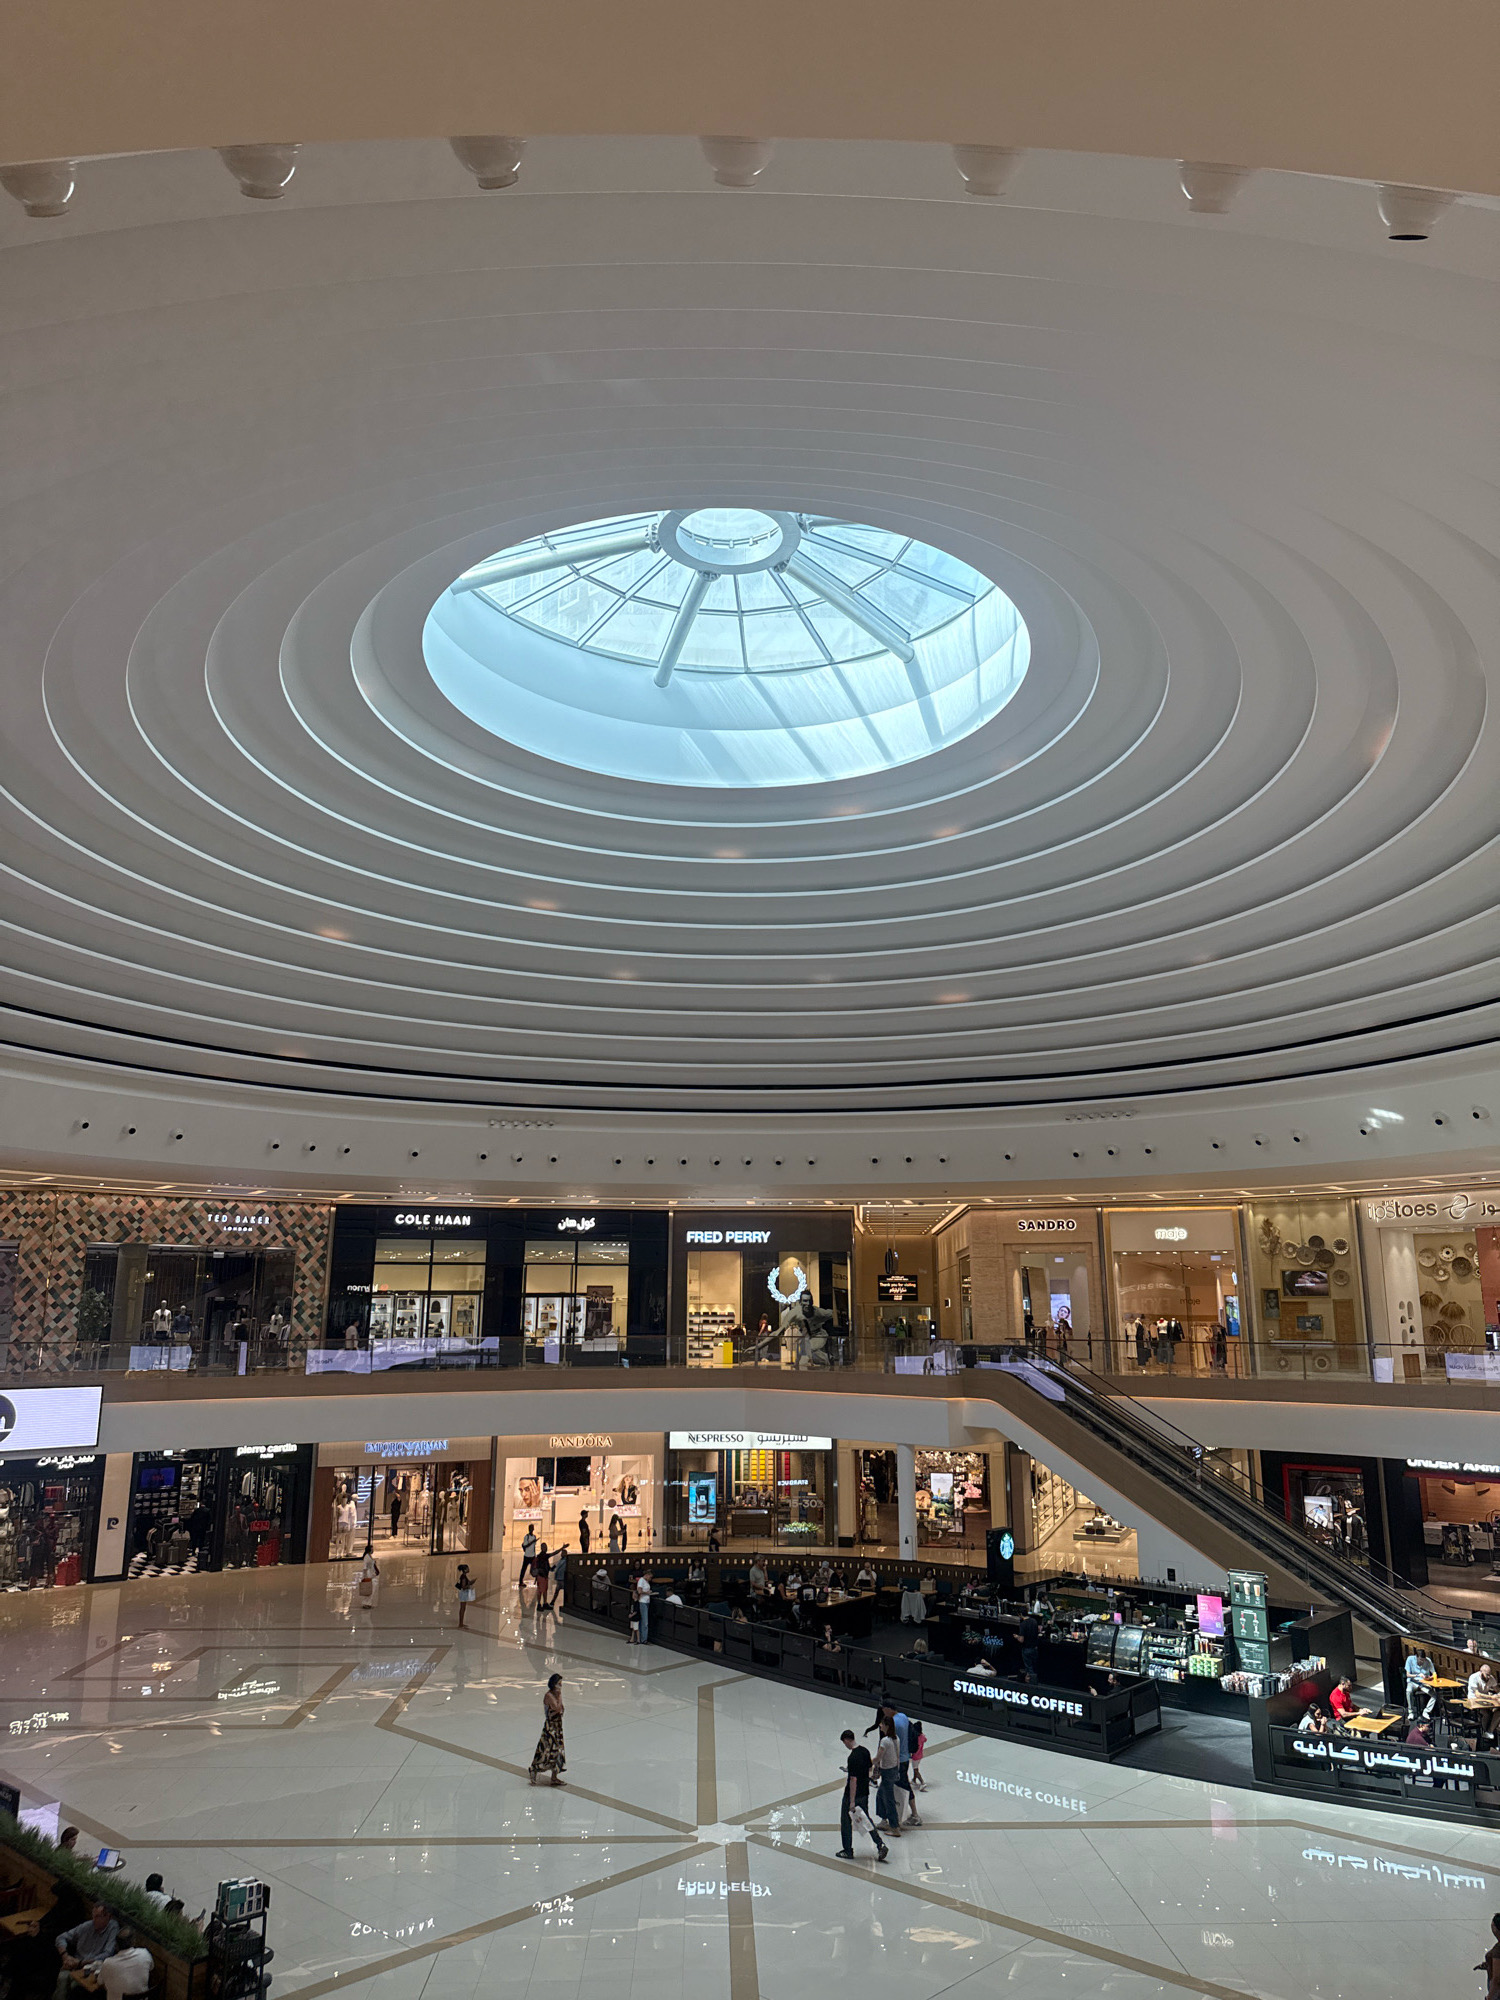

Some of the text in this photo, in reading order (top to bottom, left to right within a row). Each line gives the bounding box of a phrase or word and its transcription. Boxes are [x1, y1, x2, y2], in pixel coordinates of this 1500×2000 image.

[1395, 1200, 1438, 1218] toes
[207, 1213, 270, 1225] TED BAKER
[395, 1213, 471, 1226] COLE HAAN
[557, 1216, 596, 1231] كول هان
[1017, 1219, 1077, 1232] SANDRO
[686, 1231, 771, 1244] FRED PERRY
[1154, 1226, 1188, 1242] maje
[1179, 1298, 1201, 1306] maje
[687, 1432, 744, 1444] NESPRESSO
[236, 1442, 298, 1456] pierre cardin
[364, 1439, 449, 1453] EMPORIO ARMANI
[953, 1680, 1083, 1717] STARBUCKS COFFEE
[1293, 1740, 1475, 1777] ستاربكس كافيه
